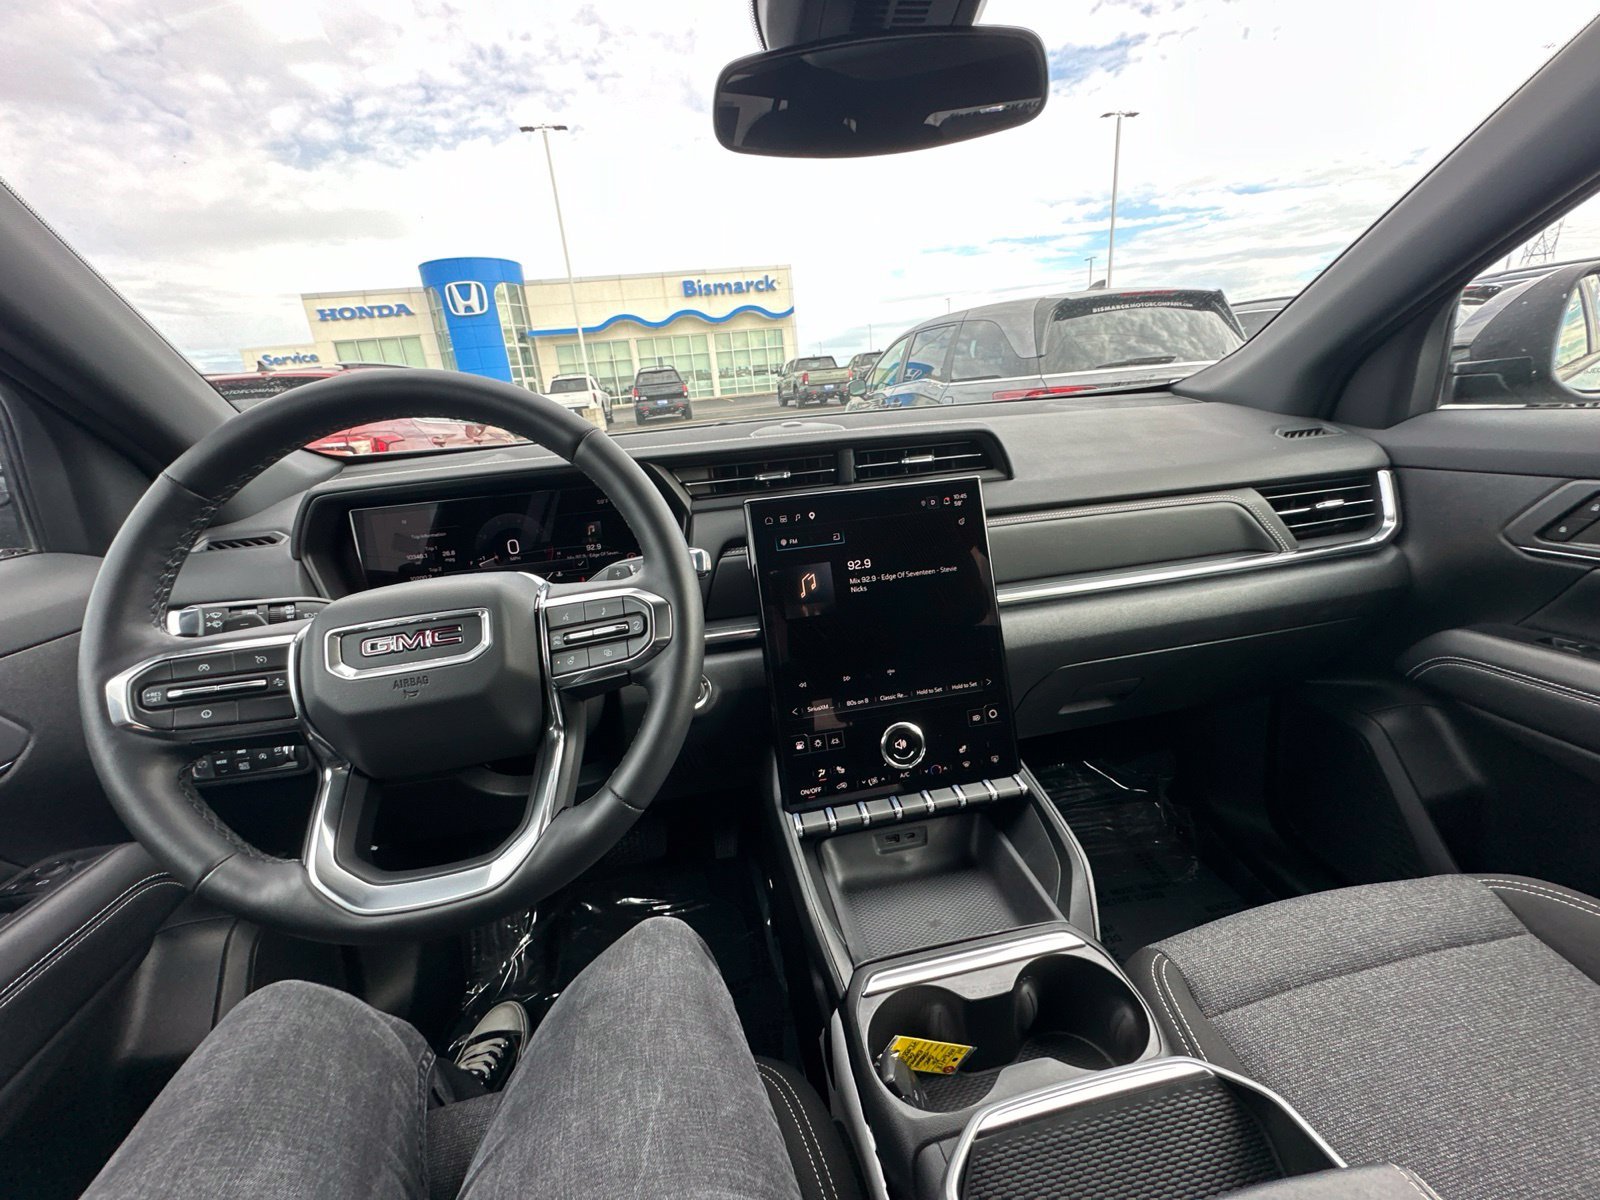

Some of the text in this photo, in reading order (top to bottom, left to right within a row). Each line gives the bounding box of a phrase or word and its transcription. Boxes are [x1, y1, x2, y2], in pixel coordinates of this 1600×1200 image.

[682, 274, 777, 298] Bismarck
[316, 303, 416, 322] HONDA
[262, 352, 319, 366] Service
[507, 539, 520, 554] 0
[586, 543, 602, 551] 92.9
[847, 558, 871, 571] 92.9
[849, 577, 861, 585] Mix
[861, 575, 877, 583] 92.9
[881, 573, 897, 581] Edge
[897, 571, 905, 579] Of
[905, 568, 936, 578] Seventeen
[940, 565, 958, 573] Stevie
[361, 624, 464, 657] GMC
[393, 675, 429, 689] AIRBAG
[880, 693, 896, 702] Classic
[917, 688, 928, 696] Hold
[800, 786, 822, 796] ON/OFF
